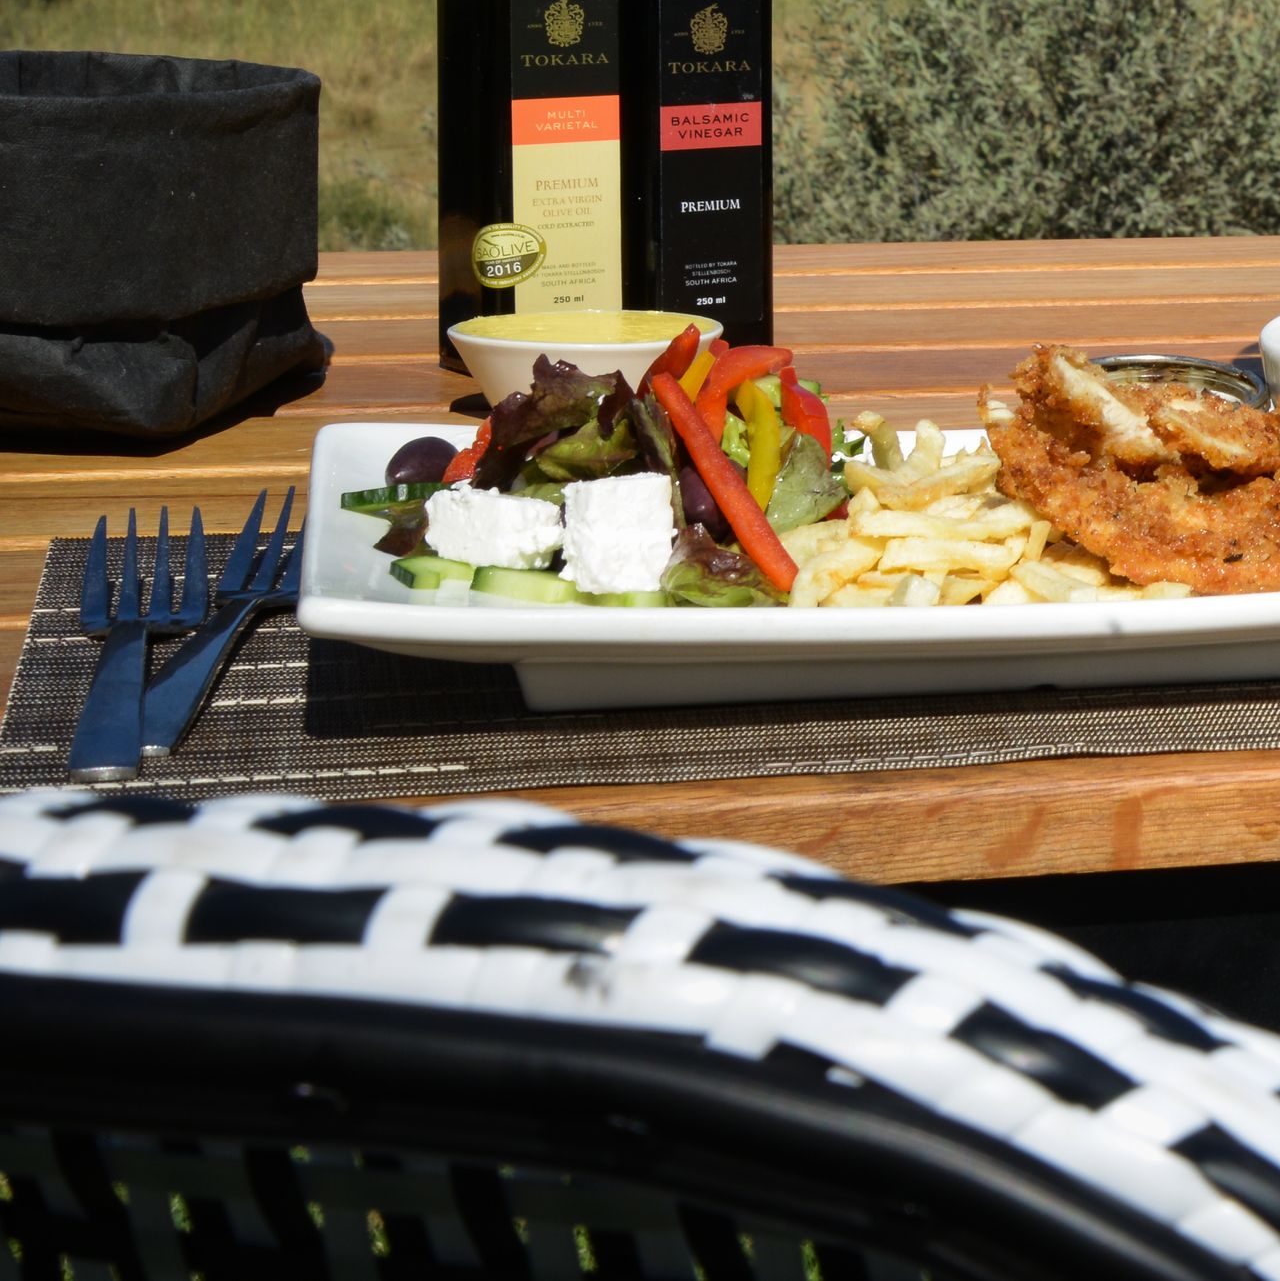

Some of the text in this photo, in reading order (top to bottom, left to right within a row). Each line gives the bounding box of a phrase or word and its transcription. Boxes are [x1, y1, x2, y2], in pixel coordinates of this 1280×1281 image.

[520, 52, 610, 67] TOKARA
[668, 60, 751, 74] TOKARA
[547, 109, 586, 120] MULTI
[671, 113, 750, 126] BALSAMIC
[535, 121, 598, 131] VARIETAL
[678, 127, 743, 139] VINEGAR
[535, 177, 599, 191] PREMIUM
[532, 194, 603, 207] EXTRA VIRGIN
[680, 199, 741, 213] PREMIUM
[542, 207, 592, 218] OLIVE OIL
[537, 222, 555, 230] COLD
[486, 261, 522, 277] 2016
[541, 279, 567, 287] SOUTH
[711, 276, 738, 284] AFRICA
[553, 294, 584, 304] 250 ml
[696, 296, 726, 306] 250 ml
